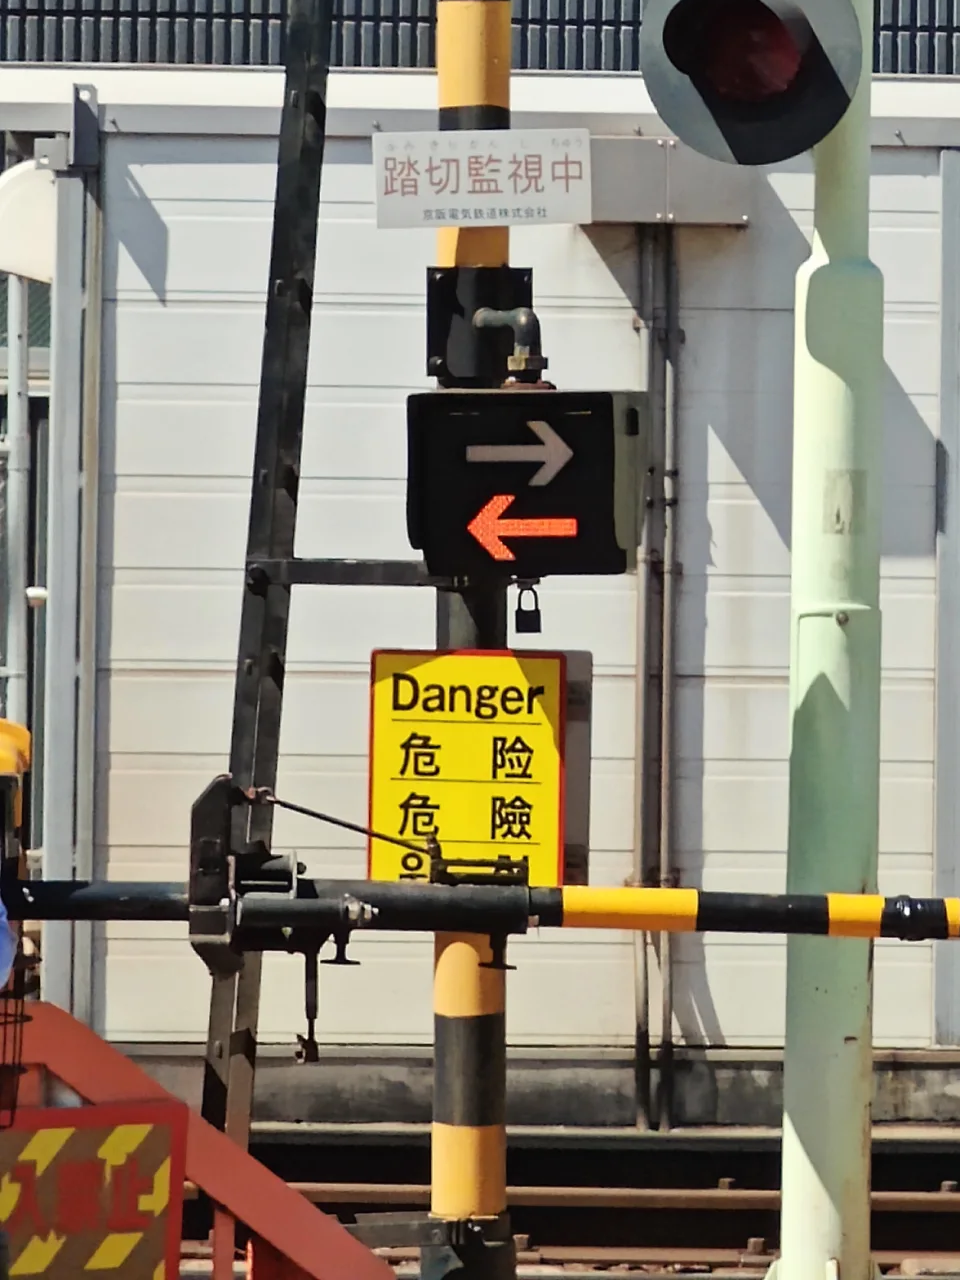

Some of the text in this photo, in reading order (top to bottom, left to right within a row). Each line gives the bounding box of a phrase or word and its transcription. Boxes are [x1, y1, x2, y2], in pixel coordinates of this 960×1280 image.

[384, 153, 584, 196] 踏切監視中
[391, 672, 545, 720] Danger
